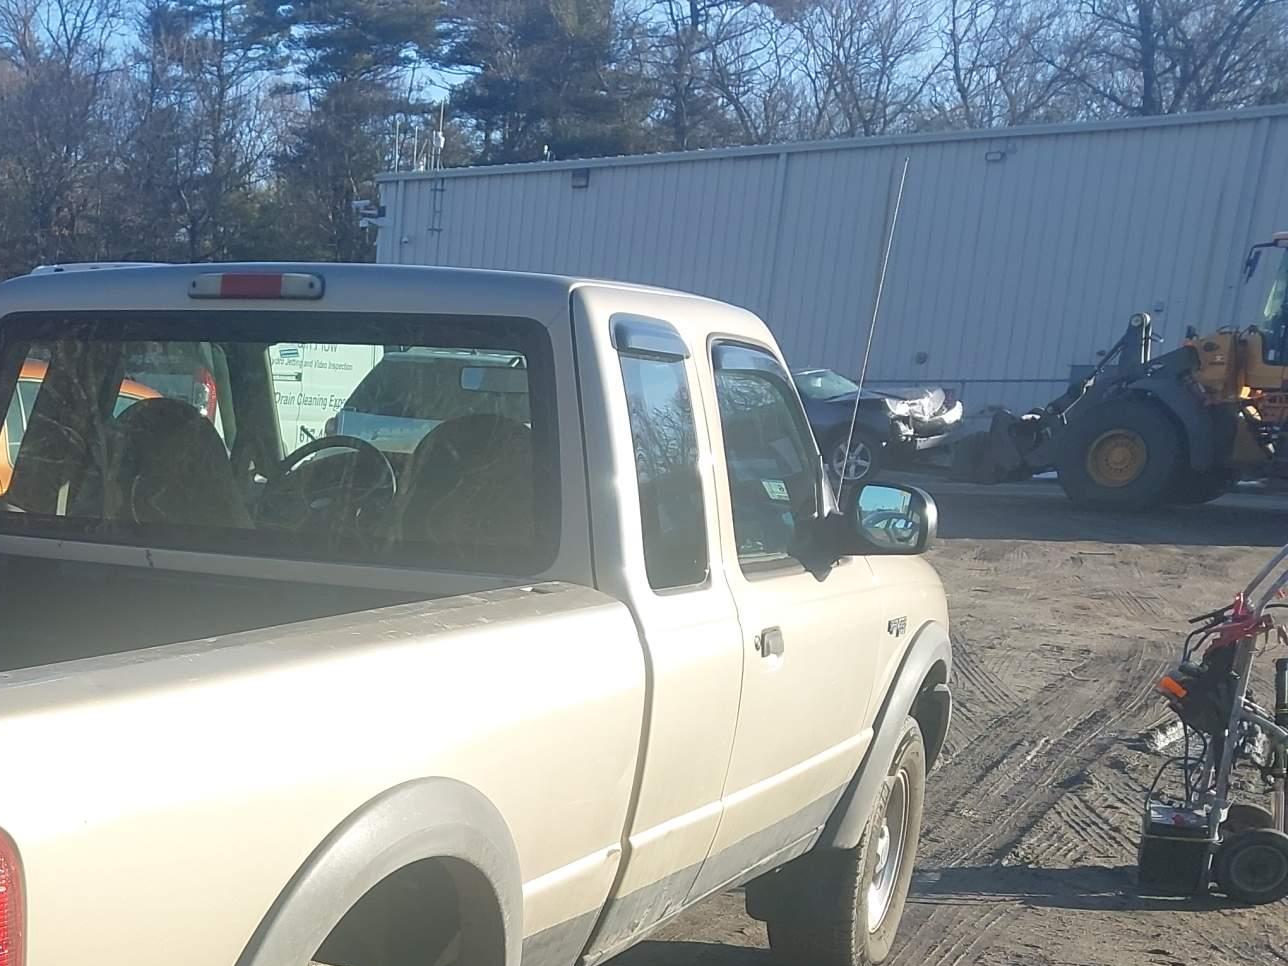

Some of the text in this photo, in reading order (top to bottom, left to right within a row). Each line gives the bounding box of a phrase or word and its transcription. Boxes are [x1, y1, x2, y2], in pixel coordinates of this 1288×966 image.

[314, 360, 328, 369] Video
[274, 391, 295, 405] Drain
[297, 393, 328, 410] Cleaning
